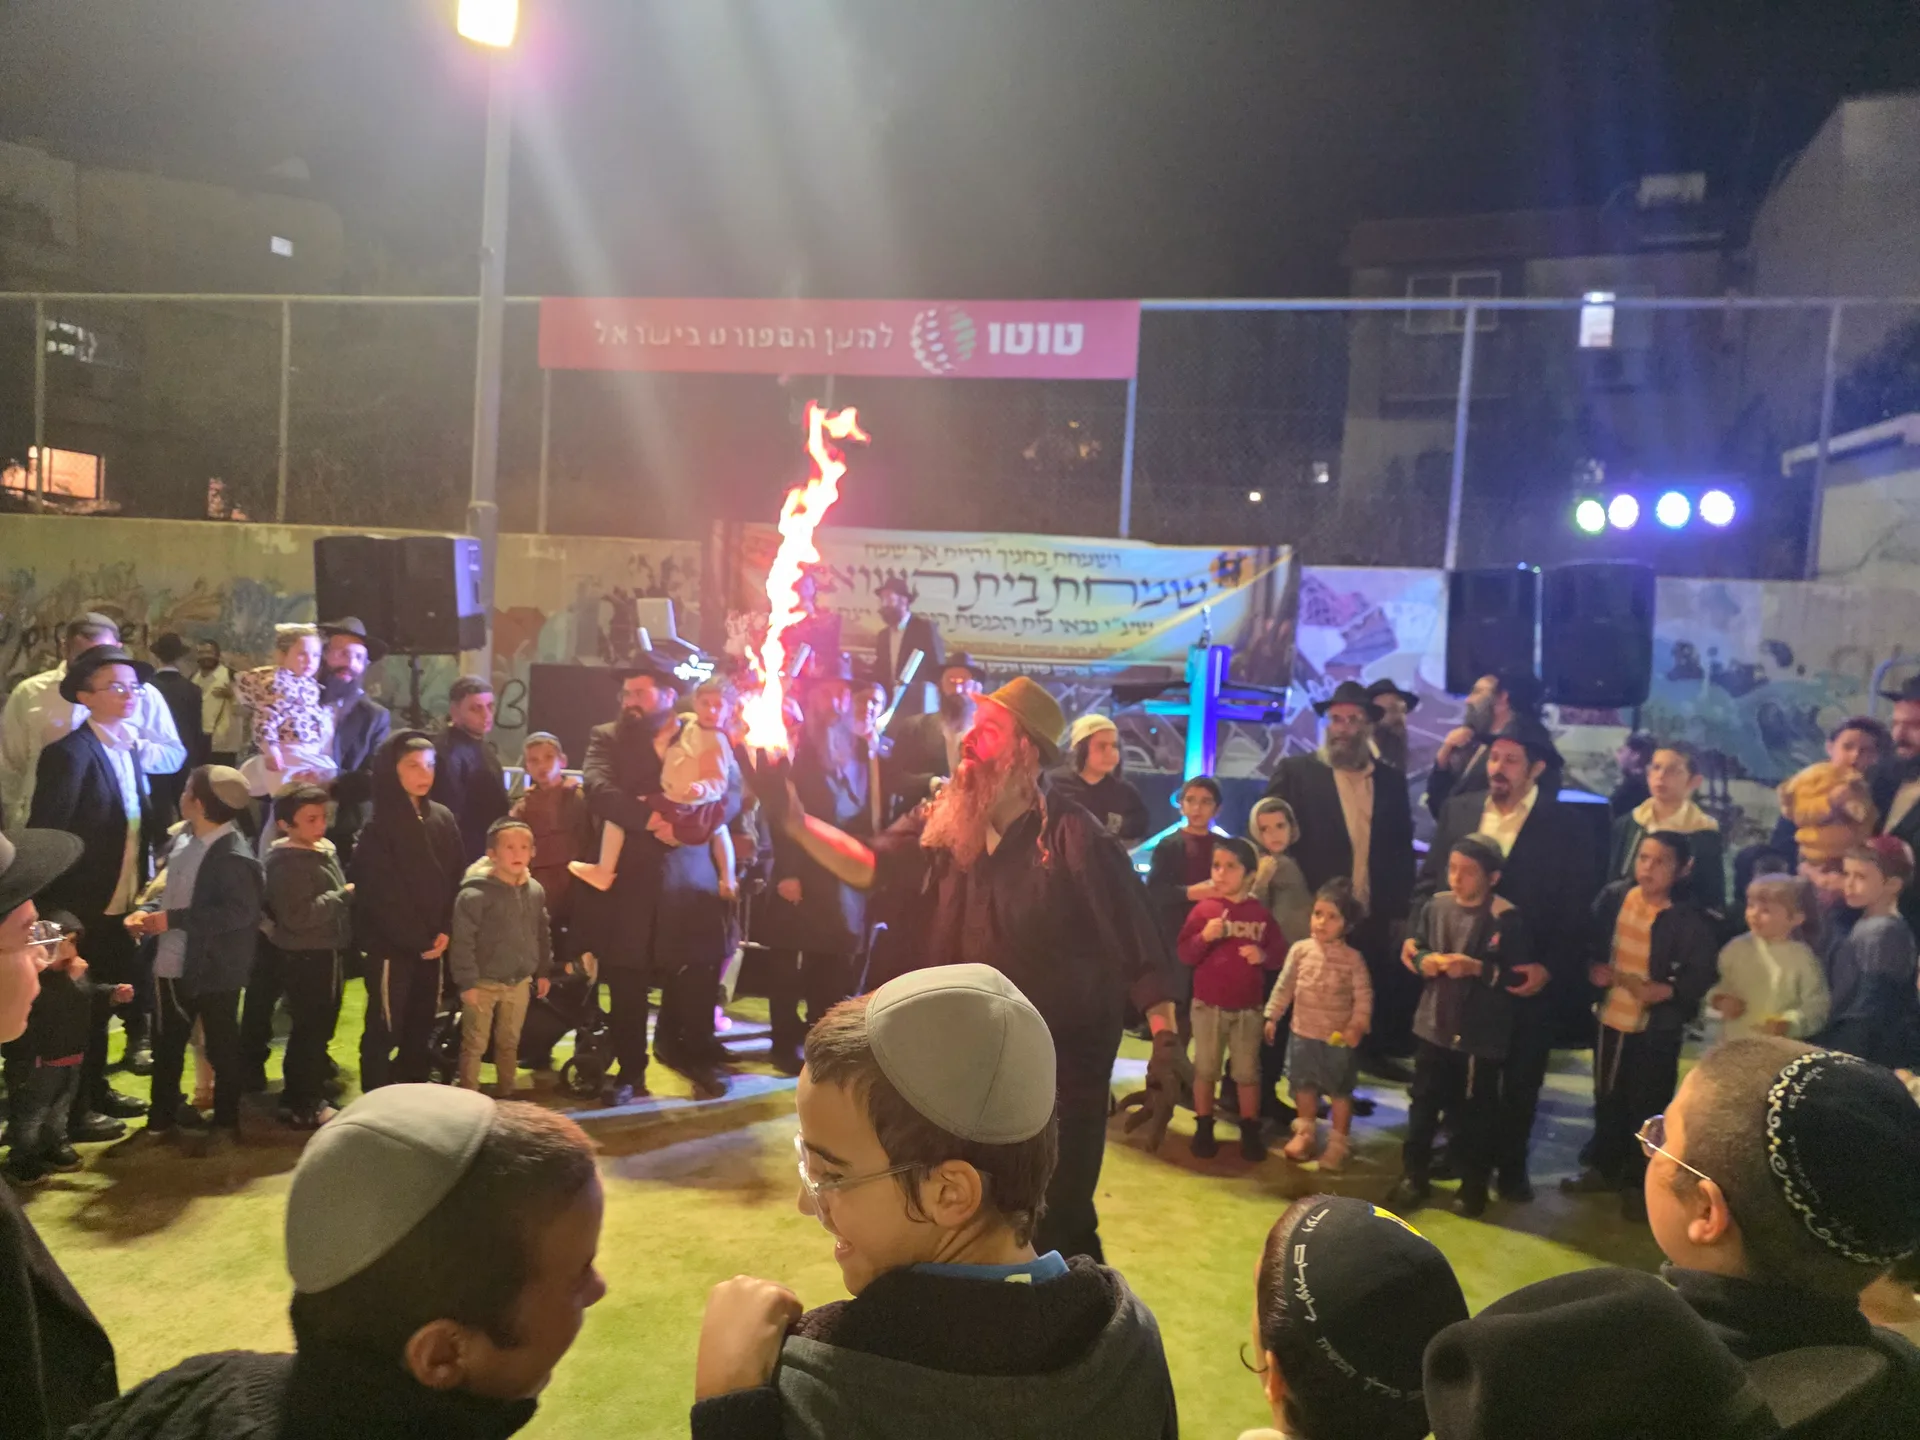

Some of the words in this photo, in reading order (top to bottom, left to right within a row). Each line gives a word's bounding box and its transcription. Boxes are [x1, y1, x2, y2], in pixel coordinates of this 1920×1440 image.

[709, 326, 816, 349] הספורט
[825, 321, 893, 356] למען
[988, 322, 1084, 355] טוטו
[914, 543, 938, 566] אך
[957, 570, 1040, 611] בית
[1035, 572, 1208, 616] שמחת
[947, 613, 1017, 633] הכנסת
[1014, 617, 1054, 637] בית
